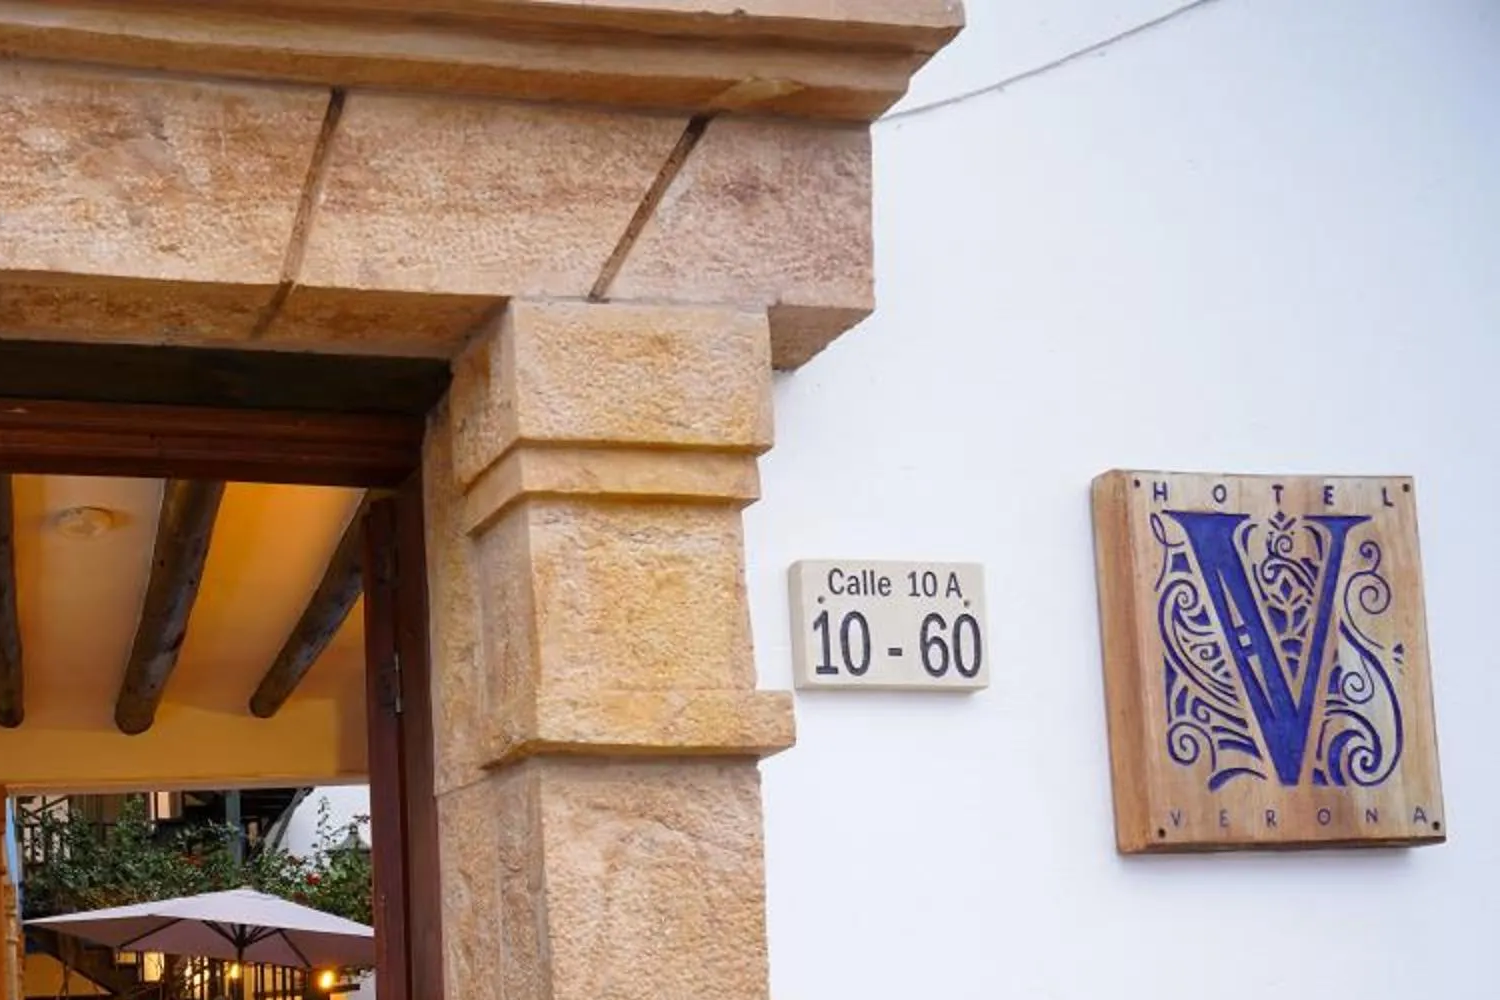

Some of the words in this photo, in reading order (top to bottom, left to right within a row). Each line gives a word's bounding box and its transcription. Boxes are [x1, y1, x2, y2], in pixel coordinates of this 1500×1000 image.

[1152, 480, 1395, 508] HOTEL
[828, 567, 892, 597] Calle
[907, 571, 938, 598] 10
[945, 571, 963, 599] A
[1169, 806, 1428, 829] VERONA
